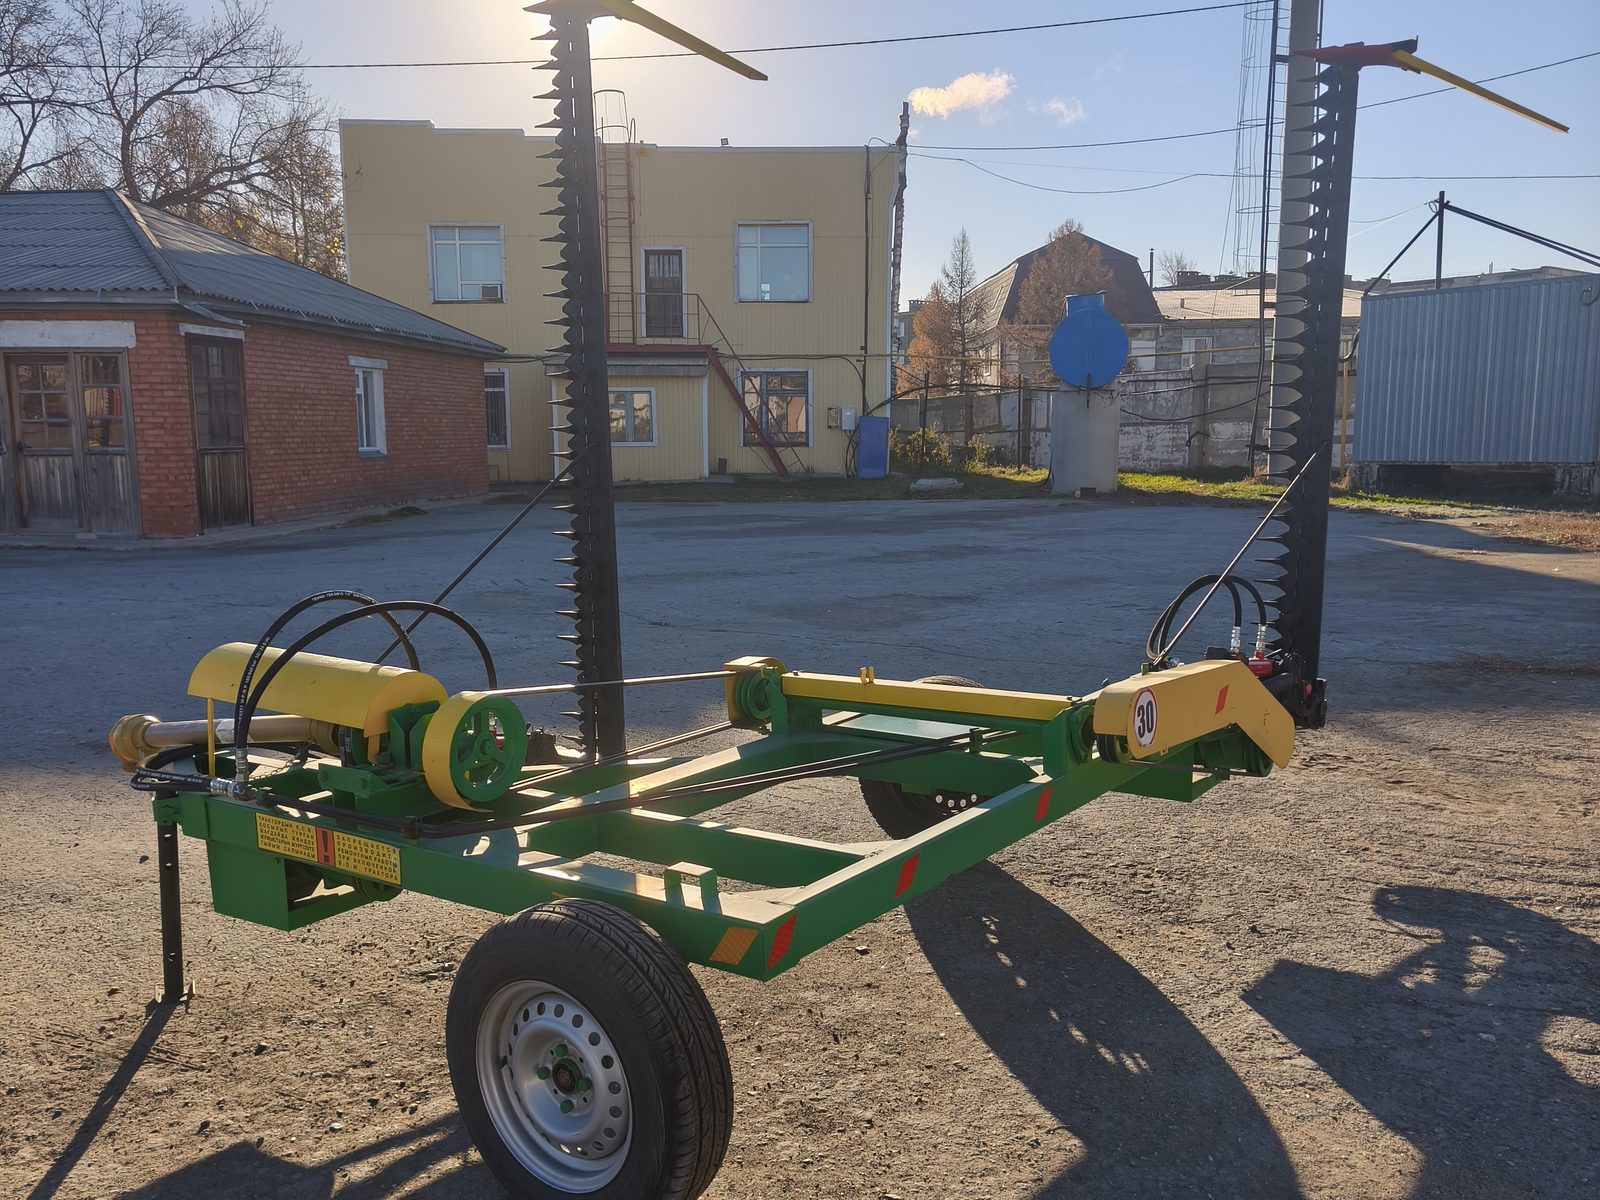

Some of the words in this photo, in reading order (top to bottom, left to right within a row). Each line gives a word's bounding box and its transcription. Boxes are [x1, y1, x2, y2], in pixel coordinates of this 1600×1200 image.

[1137, 700, 1154, 738] 30
[336, 834, 397, 854] ЗАПРЕЩАЕТСЯ
[337, 853, 350, 861] ПРИ
[364, 867, 398, 881] ТРАКТОРА
